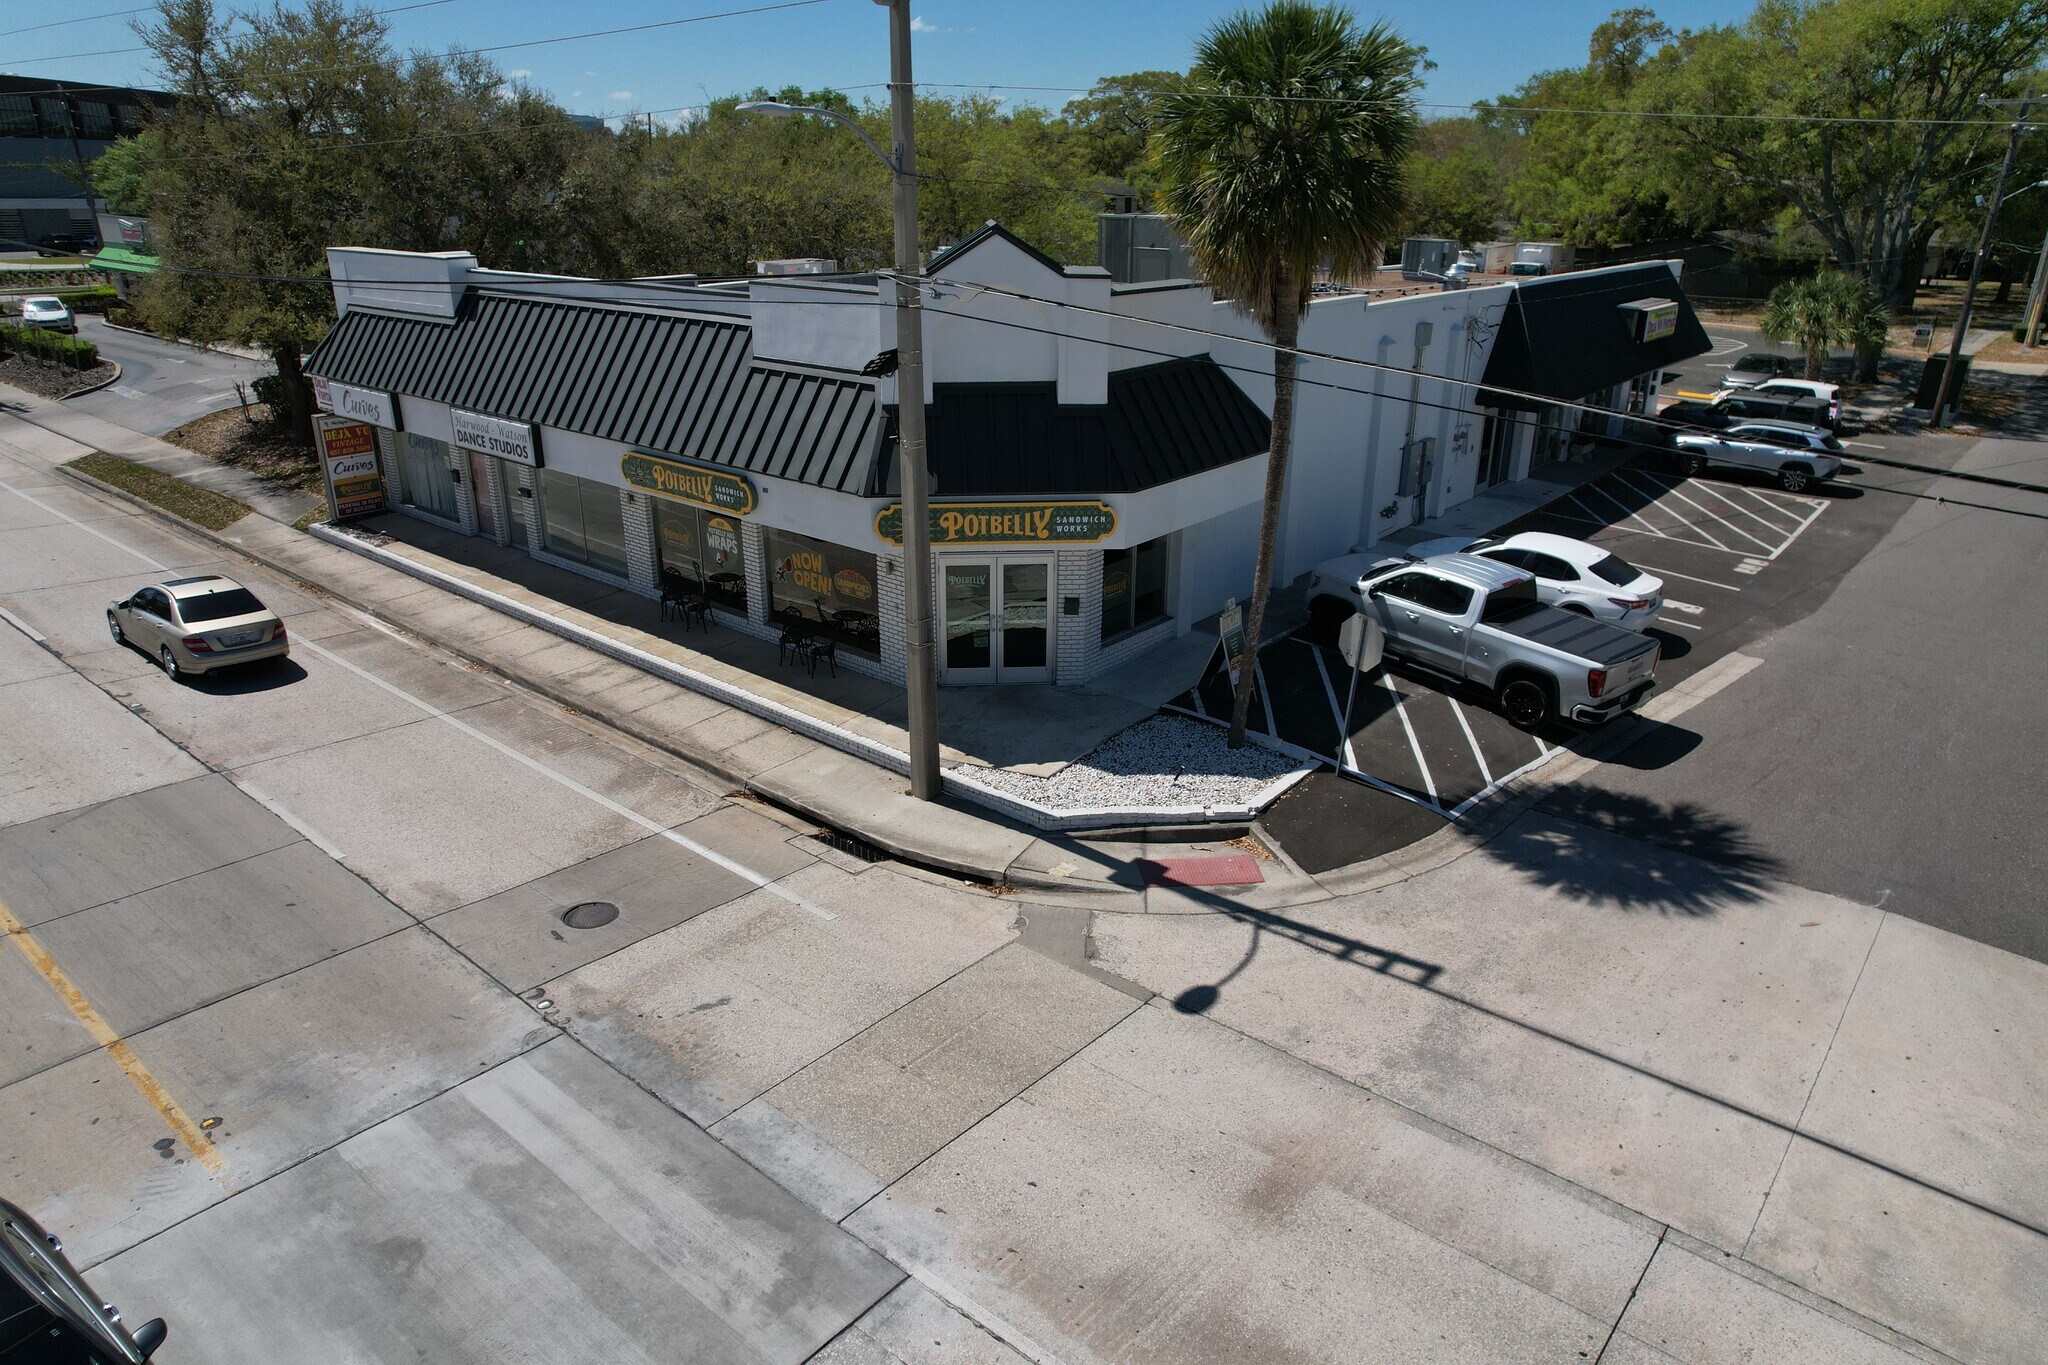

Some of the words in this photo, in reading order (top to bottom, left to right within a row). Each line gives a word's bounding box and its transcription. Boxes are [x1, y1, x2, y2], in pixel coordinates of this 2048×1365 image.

[343, 390, 380, 422] Curves
[357, 426, 369, 436] VU
[455, 416, 490, 434] Harwood
[497, 424, 527, 443] Watson
[332, 438, 364, 448] VINTAGE
[457, 429, 486, 448] DANCE
[489, 437, 529, 459] STUDIOS
[333, 460, 374, 475] Curves
[652, 464, 714, 502] POTBELLY
[714, 484, 744, 498] SANDWICH
[716, 493, 734, 503] WORKS
[338, 501, 361, 510] PARKING
[353, 503, 377, 513] BUILDING
[939, 507, 1054, 541] POTBELLY
[1056, 515, 1107, 524] SANDWICH
[1056, 525, 1088, 533] WORKS
[707, 533, 738, 554] WRAPS
[791, 552, 822, 574] NOW
[793, 570, 832, 597] OPEN!
[947, 575, 987, 585] POTBELLY
